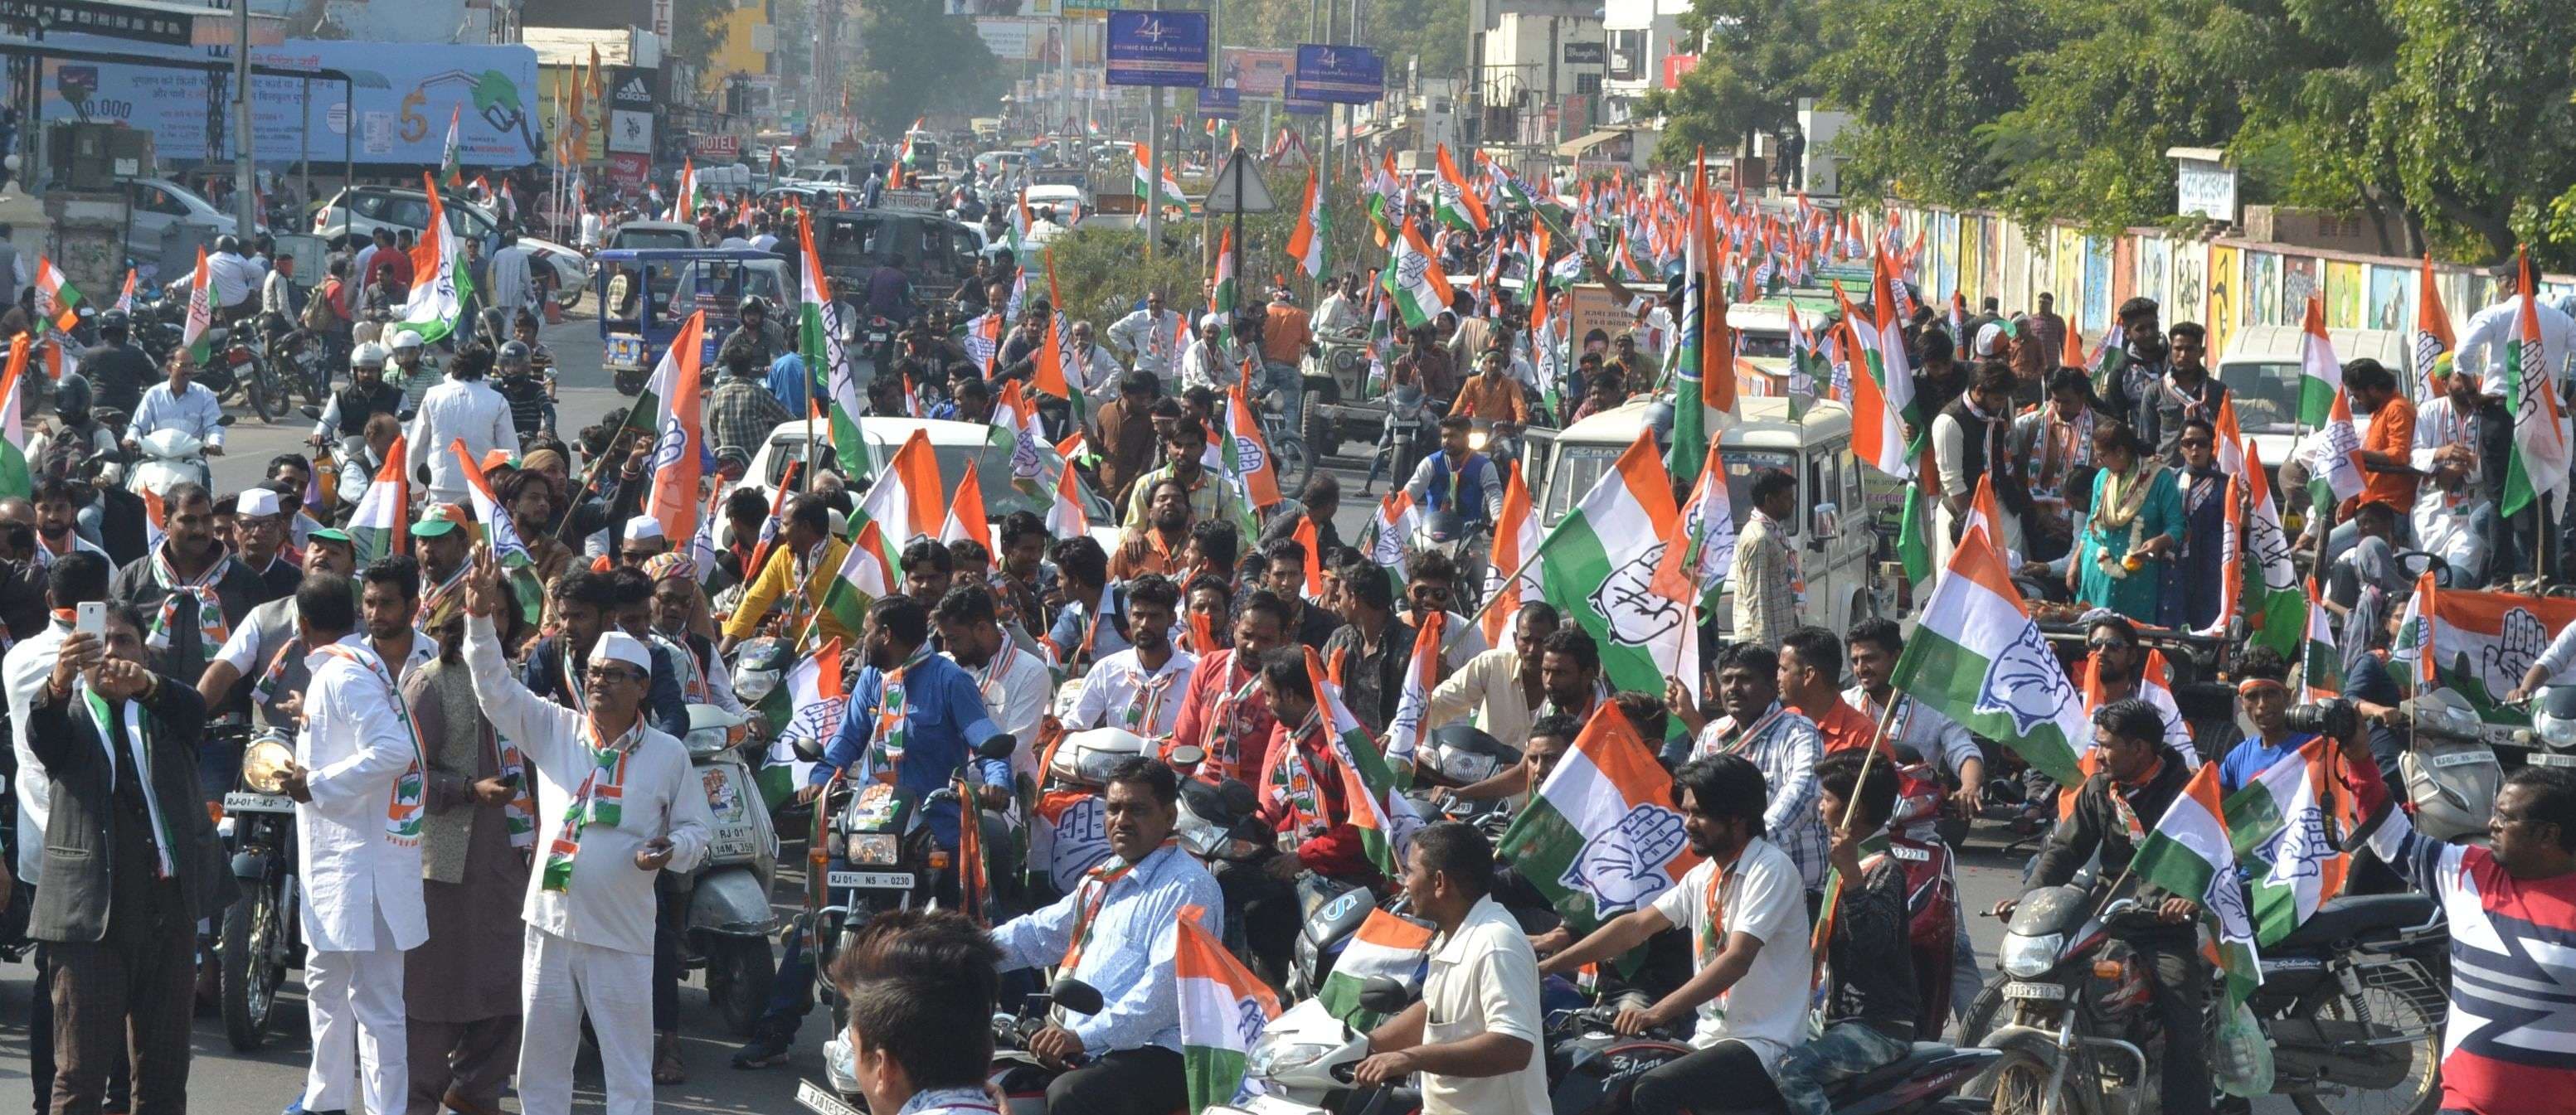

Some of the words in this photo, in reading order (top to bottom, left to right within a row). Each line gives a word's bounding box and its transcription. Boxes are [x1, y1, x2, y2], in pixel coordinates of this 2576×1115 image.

[616, 91, 651, 102] adidas
[697, 135, 736, 151] HOTEL
[865, 875, 877, 885] NS
[891, 876, 910, 885] 0230
